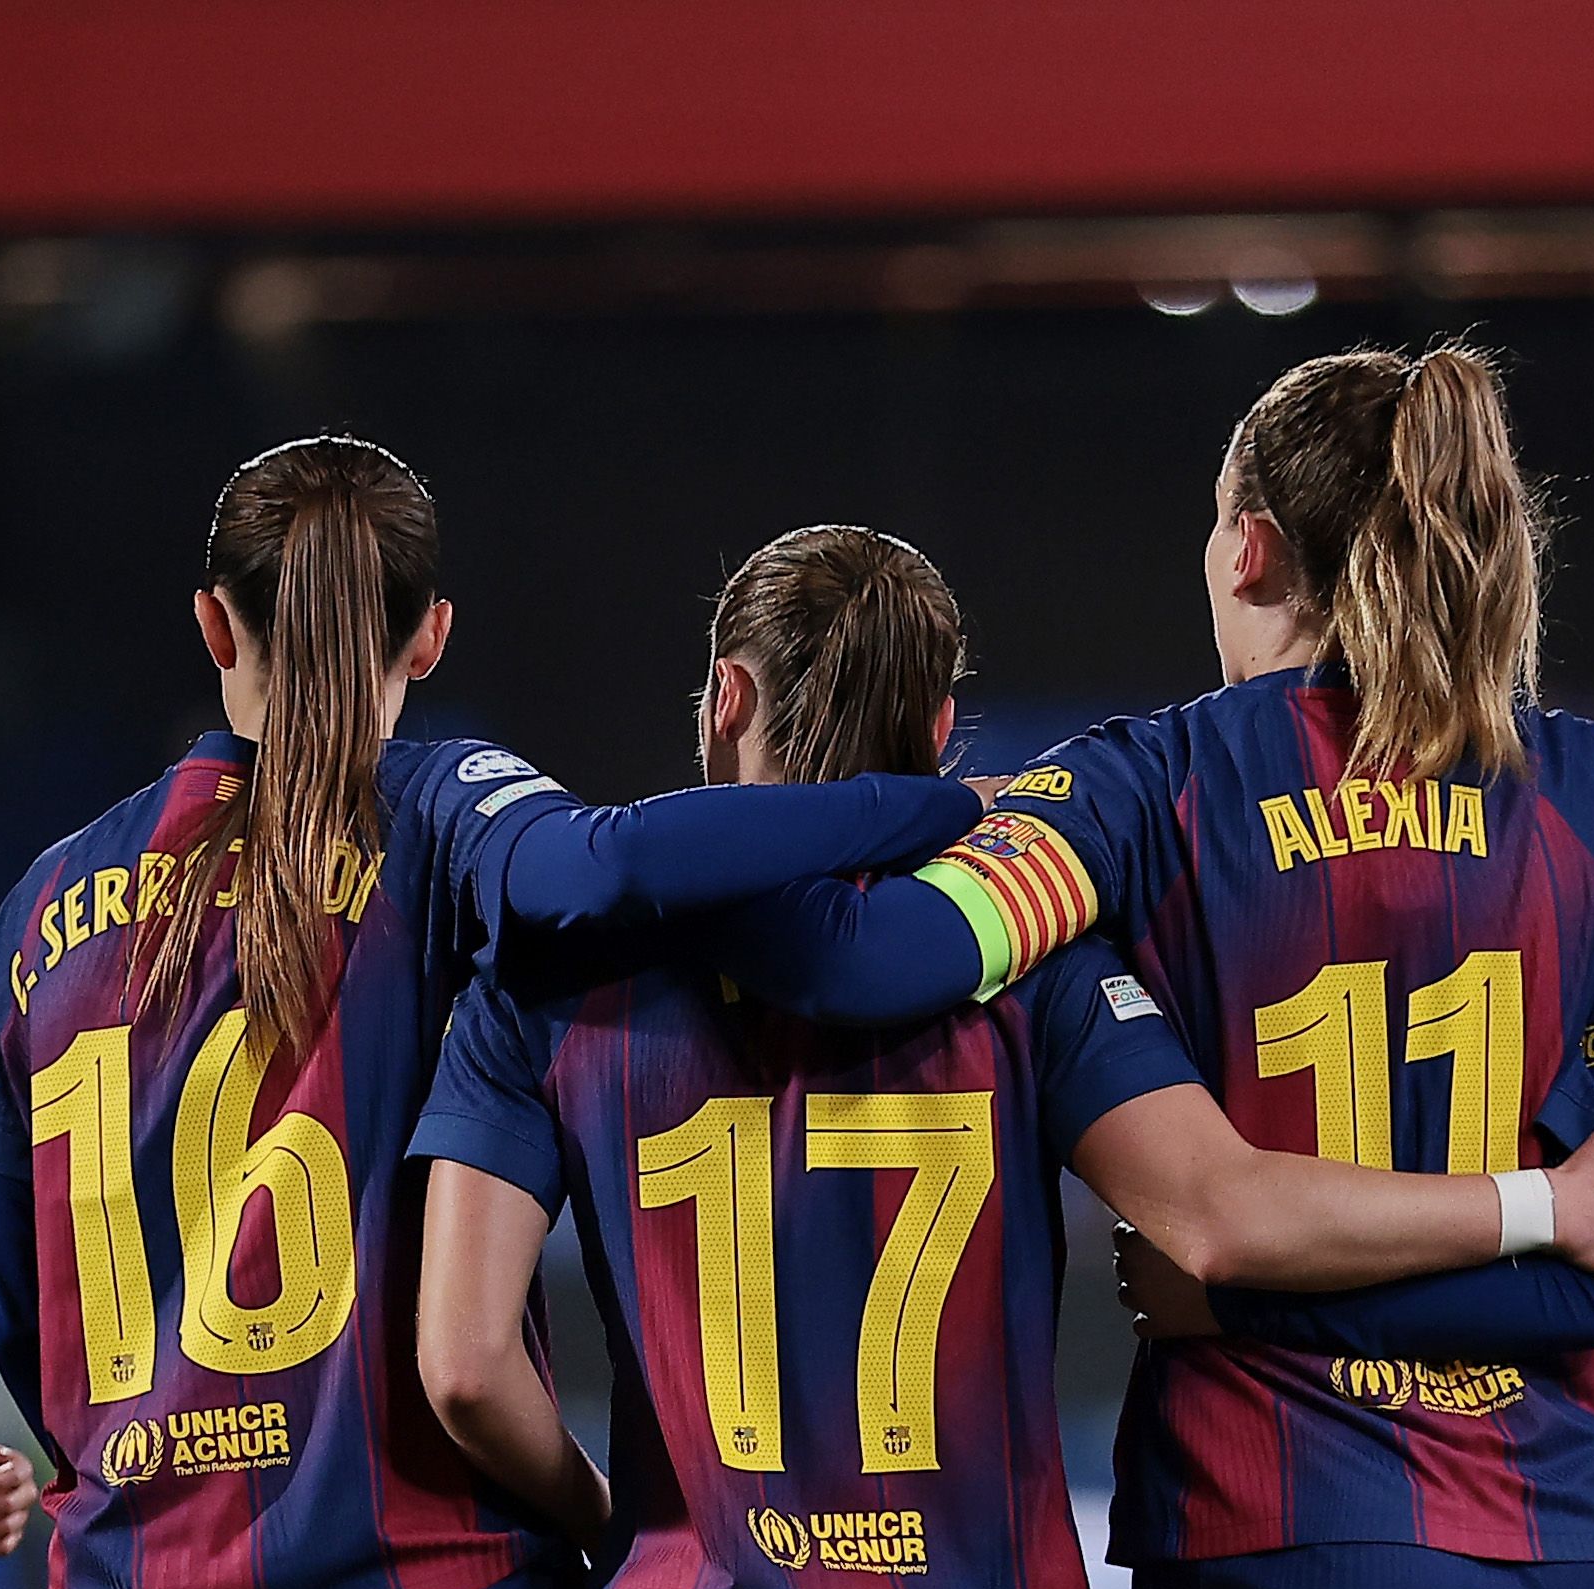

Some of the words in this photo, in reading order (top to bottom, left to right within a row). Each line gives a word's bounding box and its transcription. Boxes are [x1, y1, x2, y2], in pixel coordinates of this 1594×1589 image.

[1258, 778, 1489, 872] ALEXIA
[1255, 950, 1524, 1176] 11
[31, 1008, 357, 1405] 16
[638, 1091, 995, 1474] 17
[1418, 1367, 1526, 1407] ACNUR
[168, 1402, 287, 1439] UNHCR
[172, 1429, 290, 1466] ACNUR
[174, 1465, 194, 1477] The
[212, 1459, 251, 1473] Refugee
[252, 1456, 291, 1469] Agency
[810, 1511, 924, 1539] UNHCR
[820, 1538, 927, 1563] ACNUR
